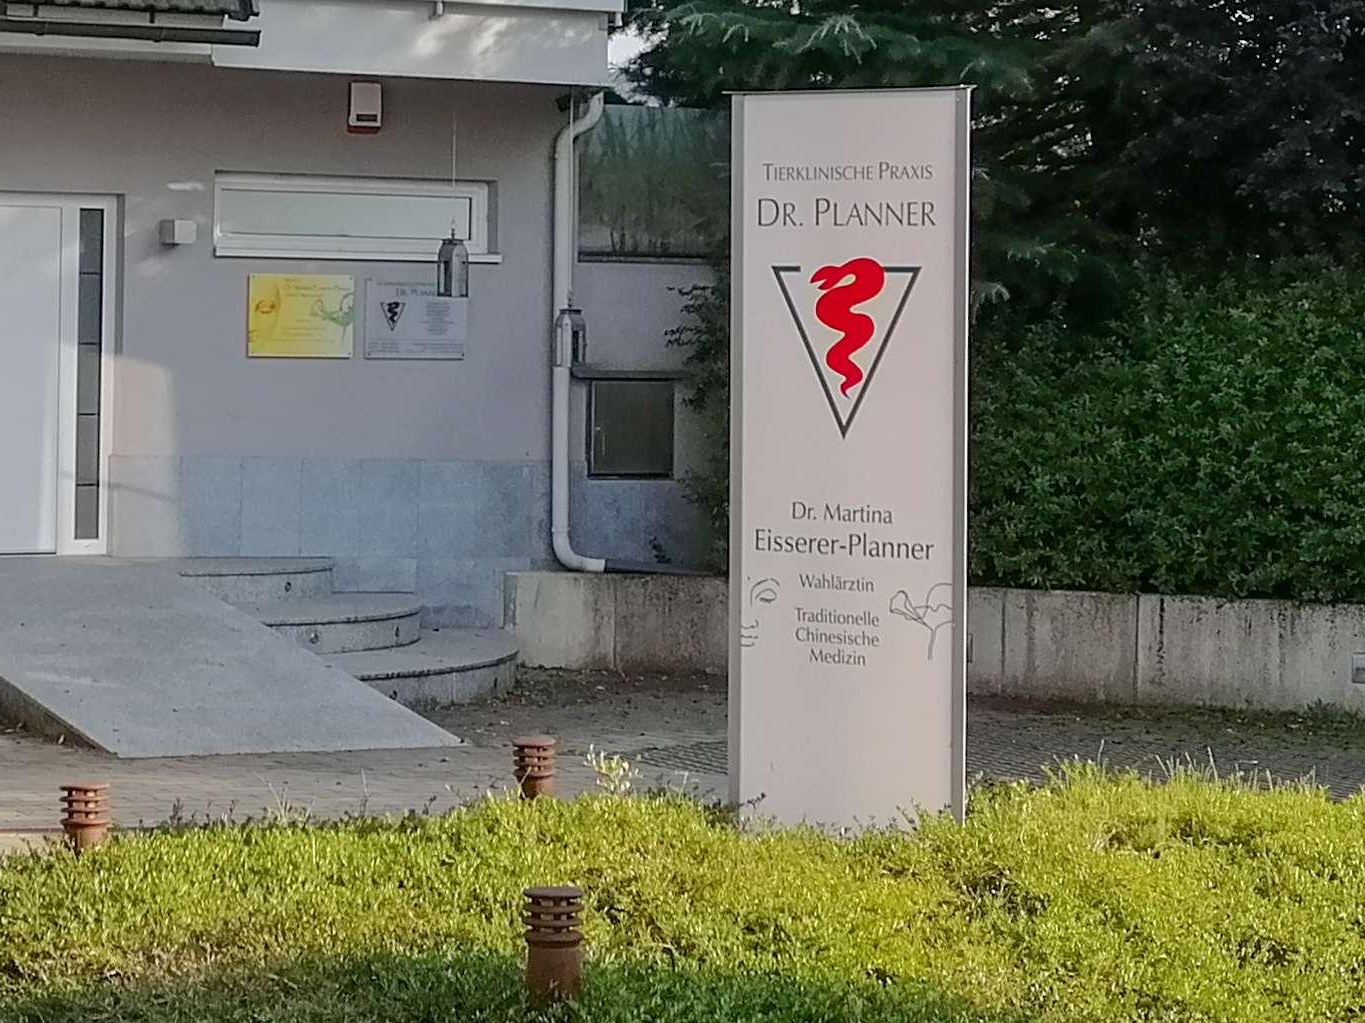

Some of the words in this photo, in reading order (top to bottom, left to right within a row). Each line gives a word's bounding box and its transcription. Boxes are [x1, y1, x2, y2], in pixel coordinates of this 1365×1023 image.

[762, 162, 874, 182] TIERKLINISCHE
[878, 161, 934, 181] PRAXIS
[757, 197, 804, 228] DR.
[814, 197, 937, 228] PLANNER
[791, 500, 818, 522] Dr.
[823, 502, 894, 525] Martina
[754, 528, 935, 561] Eisserer-Planner
[798, 572, 875, 593] Wahlärztin
[794, 606, 880, 628] Traditionelle
[794, 626, 880, 648] Chinesische
[809, 646, 867, 667] Medizin
